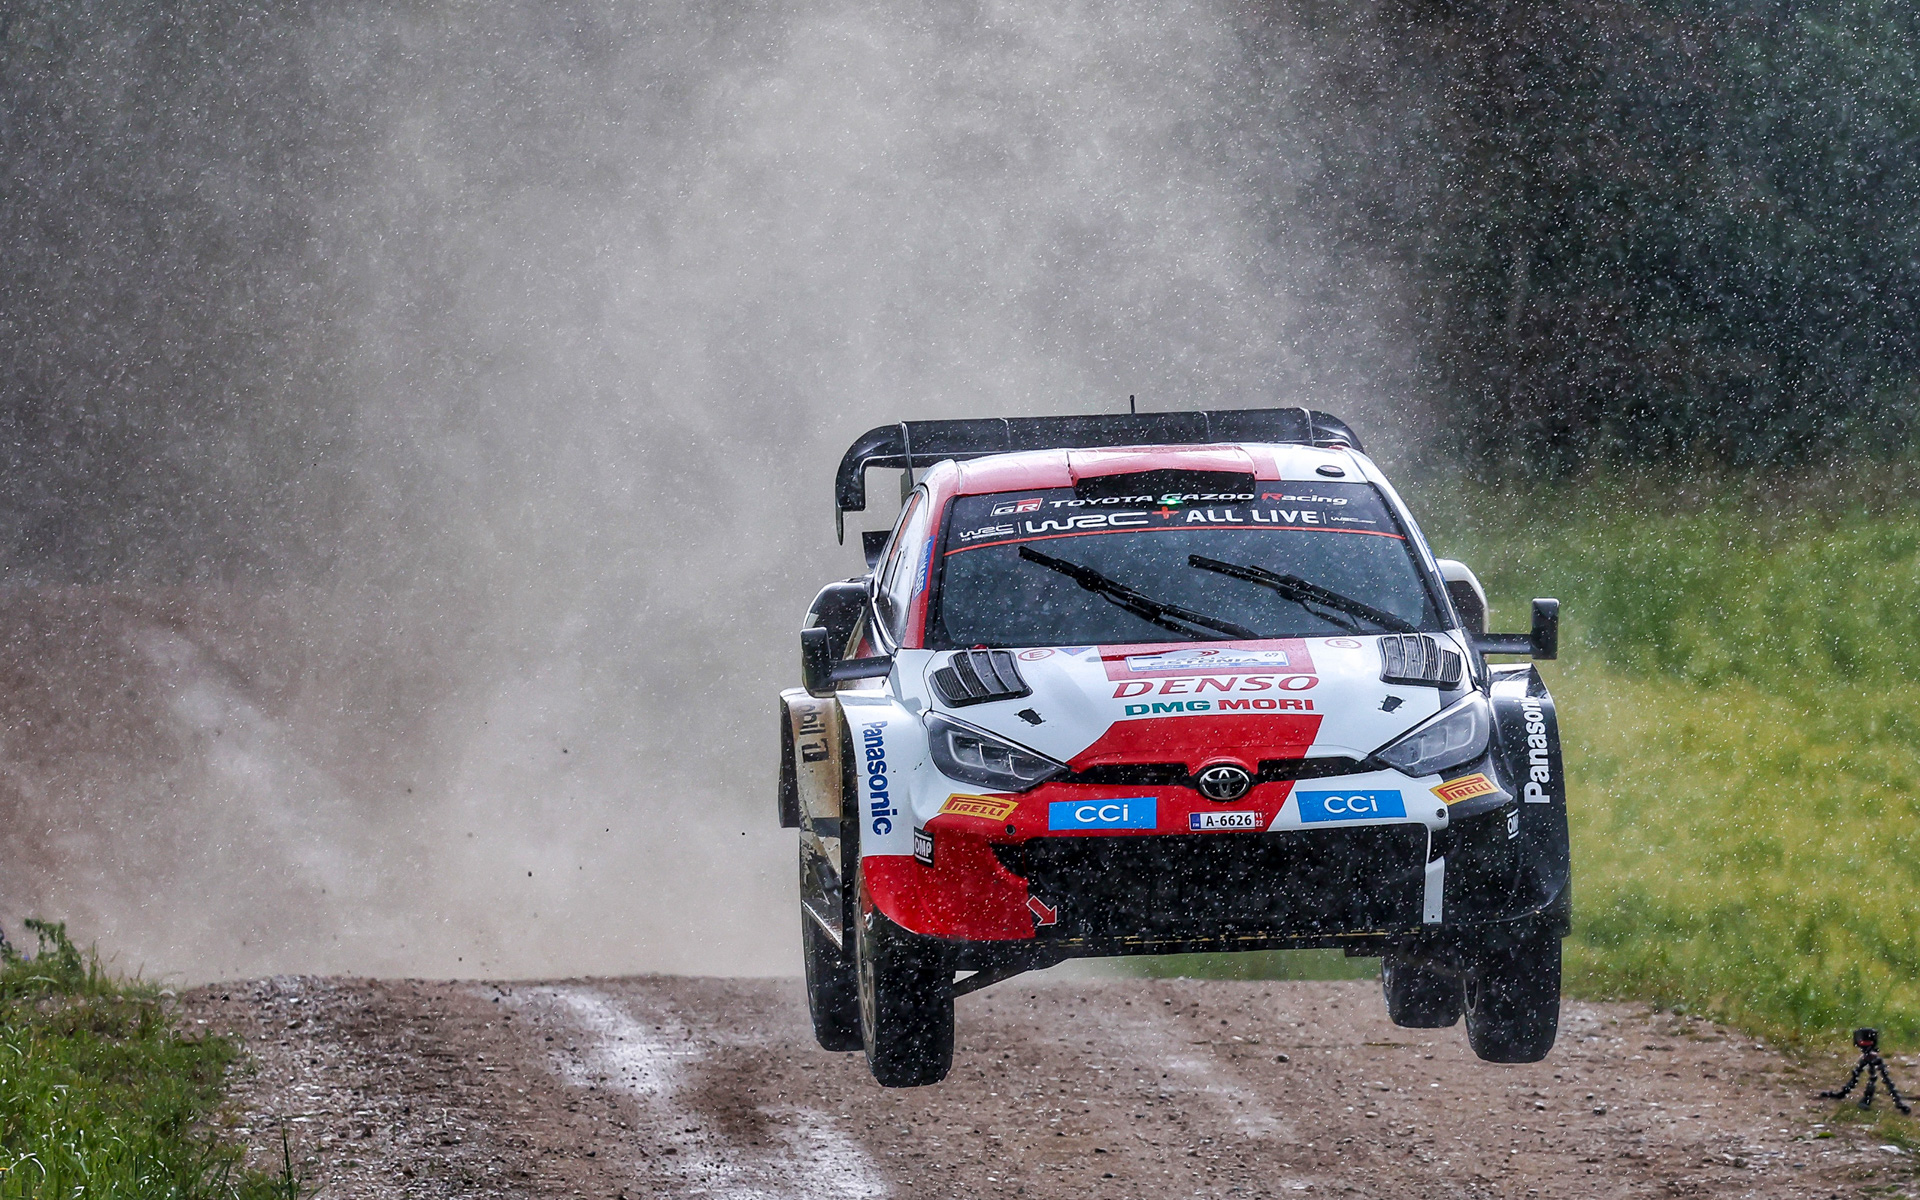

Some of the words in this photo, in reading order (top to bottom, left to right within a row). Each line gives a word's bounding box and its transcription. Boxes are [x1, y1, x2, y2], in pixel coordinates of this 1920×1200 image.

[993, 502, 1039, 516] GR
[1048, 495, 1153, 509] TOYOTA
[1160, 493, 1255, 503] GAZOO
[1261, 492, 1348, 506] Racing
[1186, 510, 1244, 523] ALL
[1250, 509, 1318, 524] LIVE
[960, 524, 1014, 538] WRC
[1112, 676, 1319, 699] DENSO
[1125, 700, 1210, 716] DMG
[1218, 699, 1315, 711] MORI
[862, 720, 898, 836] Panasonic
[1437, 776, 1493, 801] PIRELLI
[945, 796, 1011, 817] PIRELLI
[1205, 814, 1252, 827] A-6626
[914, 836, 932, 858] OMP
